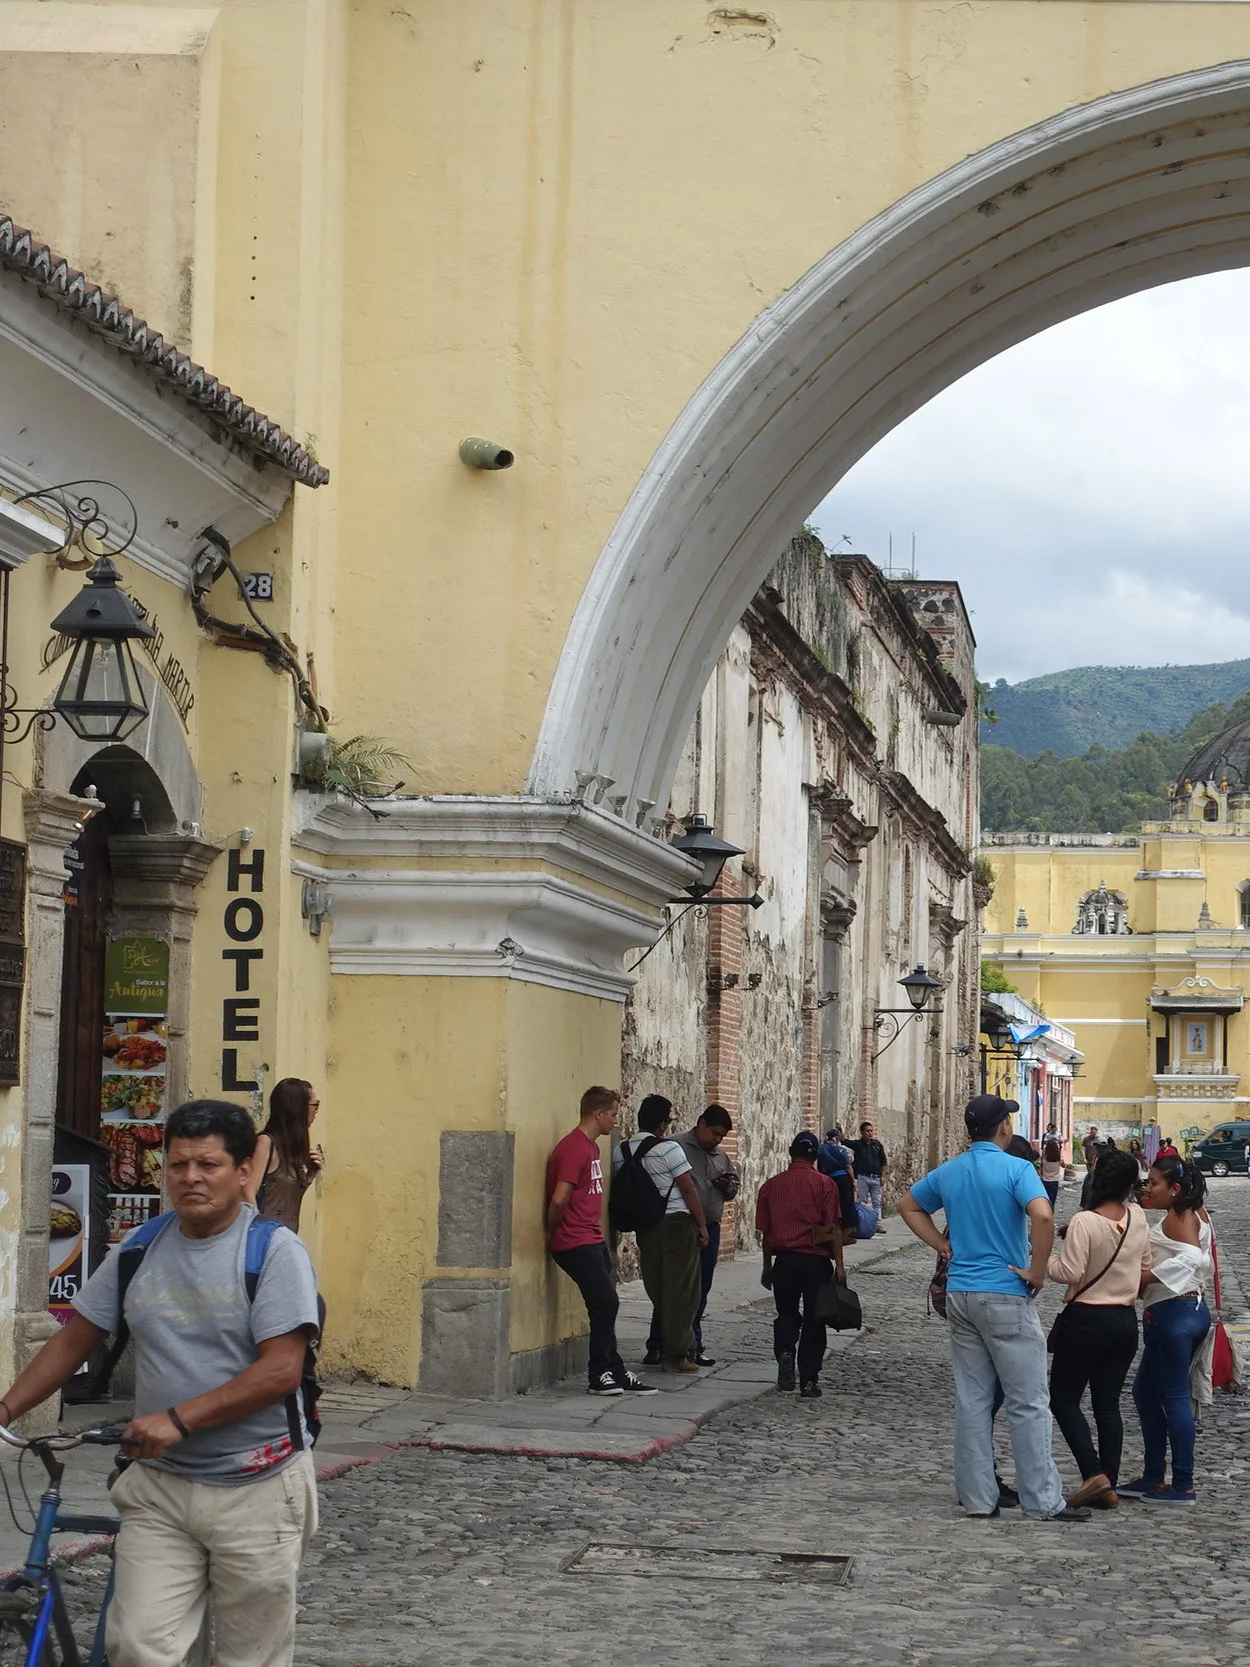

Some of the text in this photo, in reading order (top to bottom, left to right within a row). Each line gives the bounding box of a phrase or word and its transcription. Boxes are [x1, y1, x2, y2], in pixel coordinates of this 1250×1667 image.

[243, 575, 271, 597] 28
[222, 849, 265, 1092] HOTEL
[109, 981, 164, 1001] Antigua
[135, 978, 154, 986] Sabor
